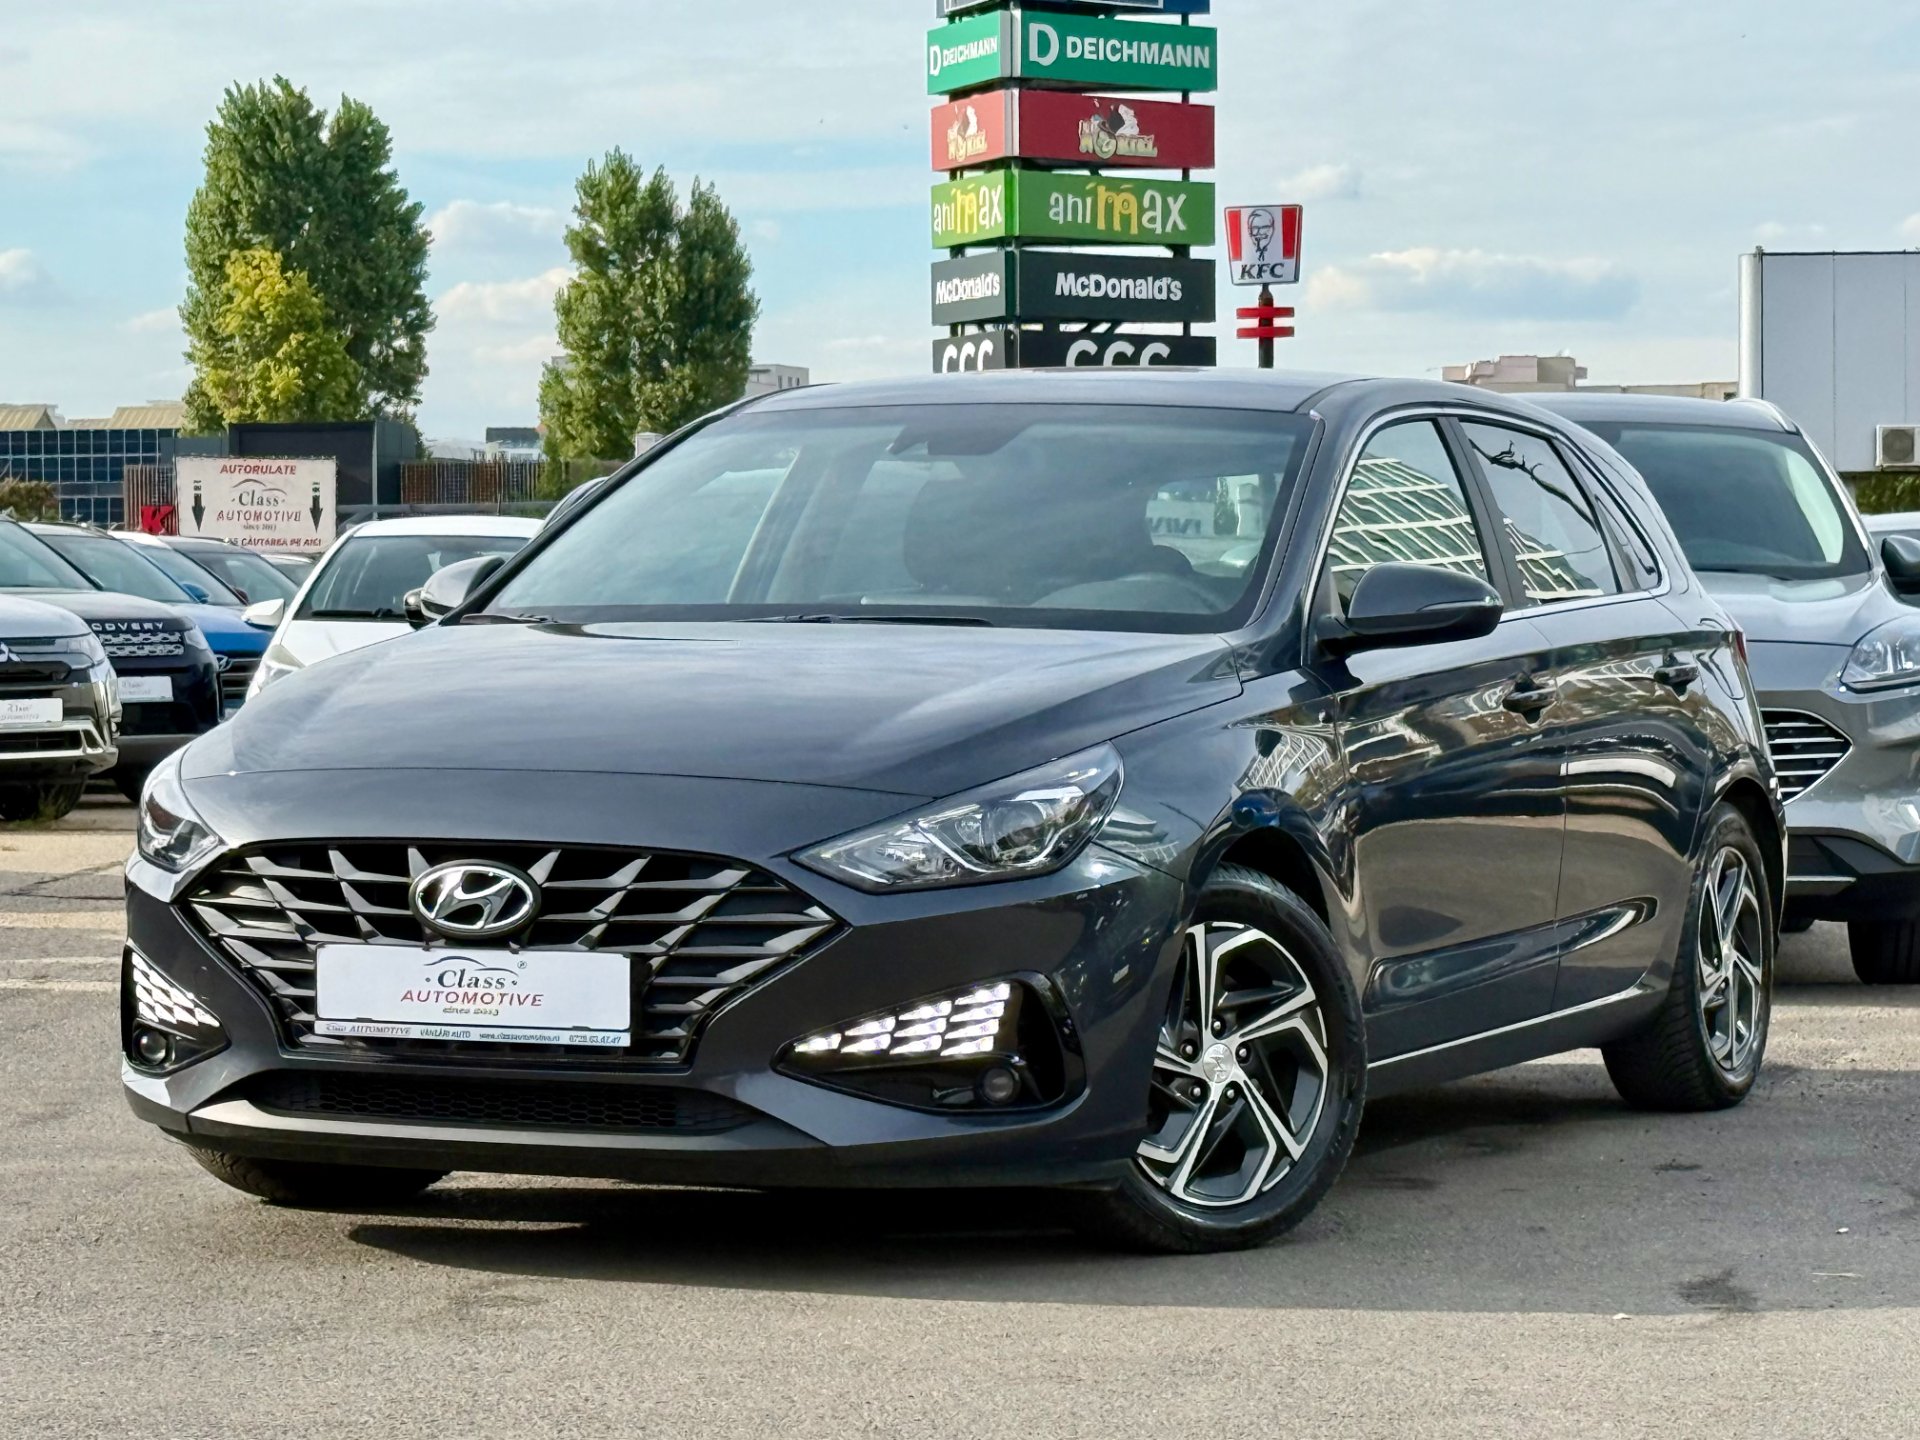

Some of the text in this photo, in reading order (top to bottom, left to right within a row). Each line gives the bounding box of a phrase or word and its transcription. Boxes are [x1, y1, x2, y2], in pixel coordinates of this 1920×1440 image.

[943, 36, 998, 67] DEICHMANN
[1066, 36, 1211, 68] DEICHMANN
[933, 184, 1003, 235] animax
[1049, 182, 1188, 235] animax
[1239, 263, 1285, 280] KFC
[935, 272, 1001, 305] McDonald's
[1055, 272, 1182, 301] McDonald's
[220, 465, 297, 475] AUTORULATE
[238, 489, 280, 507] Class
[216, 510, 302, 522] AUTOMOTIVE
[437, 968, 506, 990] Class
[400, 989, 545, 1007] AUTOMOTIVE
[350, 1025, 412, 1035] AUTOMOTIVE
